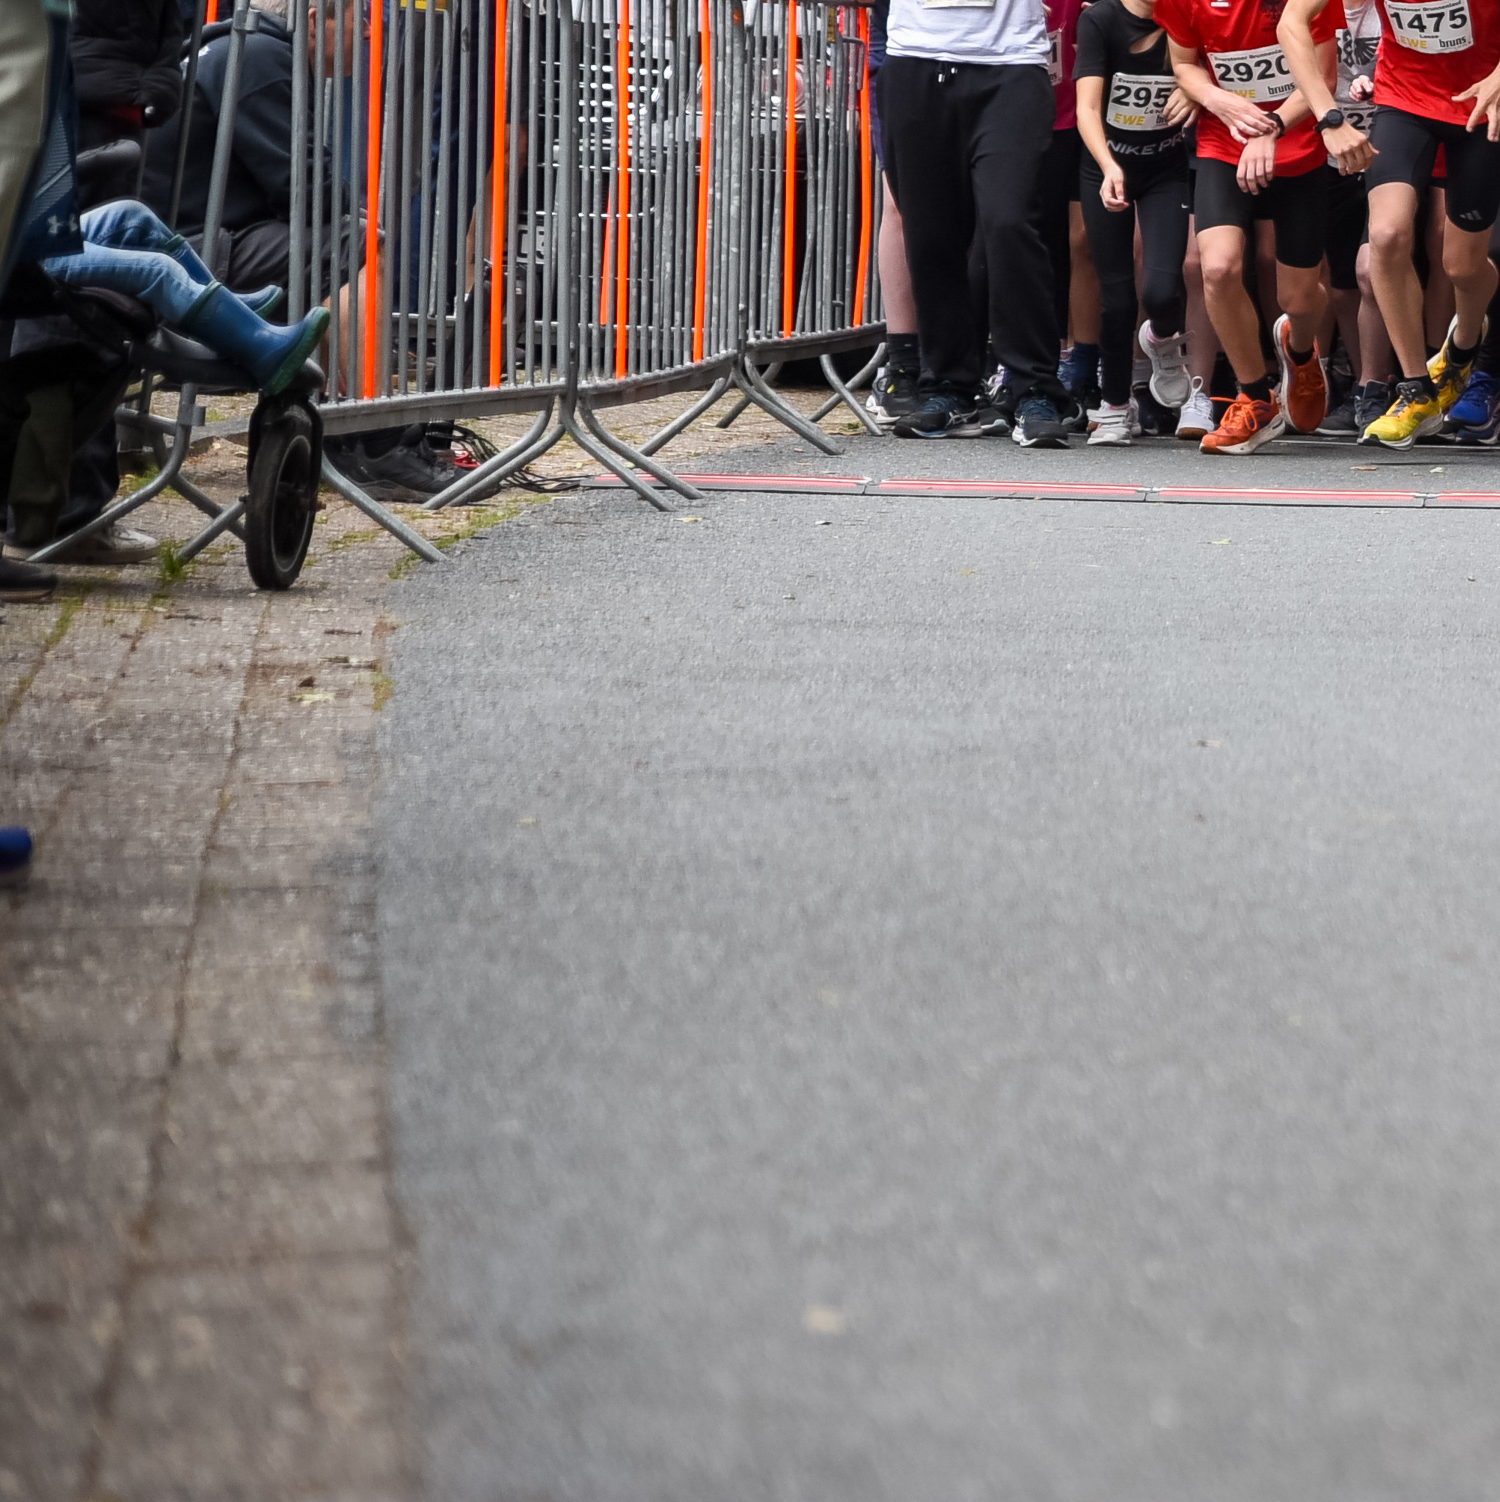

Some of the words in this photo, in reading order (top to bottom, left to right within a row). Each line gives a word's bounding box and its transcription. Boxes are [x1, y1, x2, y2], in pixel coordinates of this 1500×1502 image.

[1390, 6, 1467, 33] 1475
[1400, 35, 1427, 49] EWE
[1439, 35, 1467, 48] bruns
[1111, 85, 1172, 108] 295
[1227, 89, 1256, 98] WE
[1267, 82, 1295, 95] bruns
[1114, 113, 1146, 126] EWE
[1106, 139, 1157, 155] NIKE
[1158, 132, 1181, 153] PR
